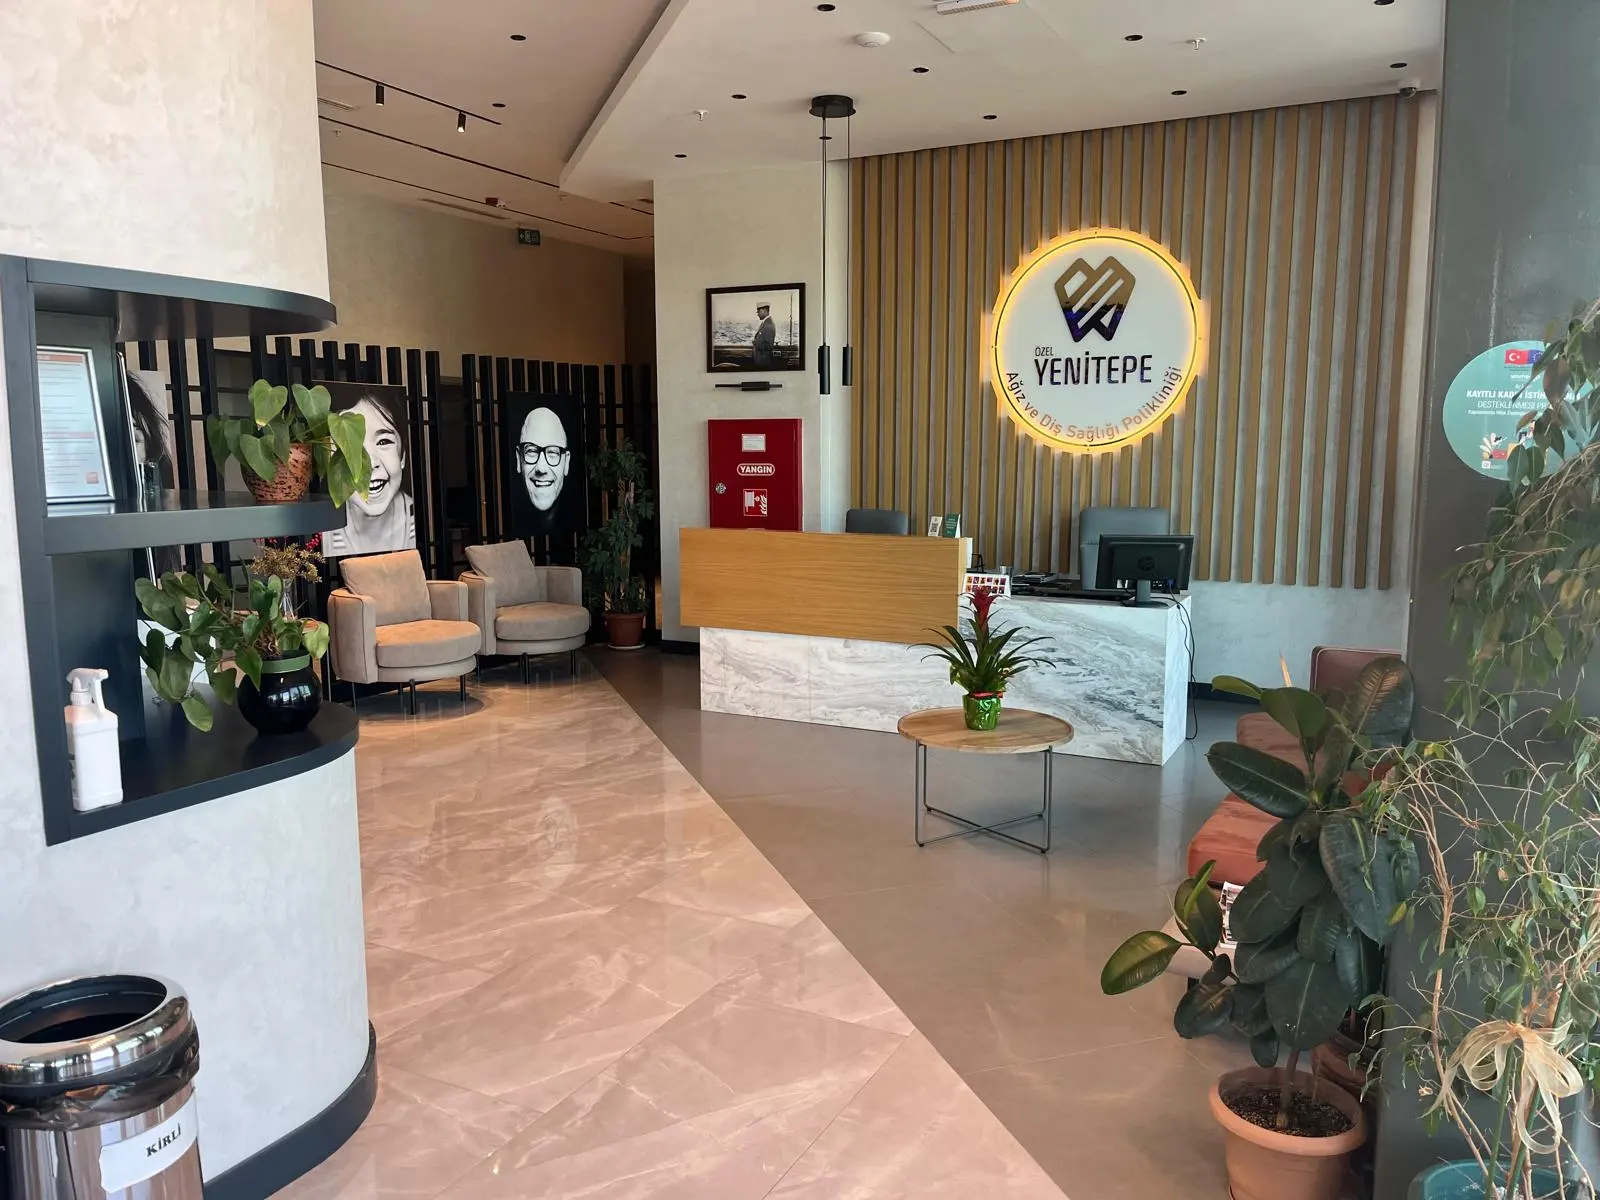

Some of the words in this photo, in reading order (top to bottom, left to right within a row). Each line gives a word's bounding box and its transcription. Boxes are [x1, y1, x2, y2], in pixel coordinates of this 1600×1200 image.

[1034, 346, 1054, 357] ÖZEL
[1034, 350, 1153, 386] YENİTEPE
[1006, 372, 1026, 403] Ağız
[1024, 402, 1039, 419] ve
[1039, 413, 1063, 437] Diş
[1066, 422, 1120, 442] Sağlığı
[1122, 365, 1183, 432] Polikliniği
[740, 465, 773, 474] YANGIN
[146, 1122, 182, 1158] KİRLİ
